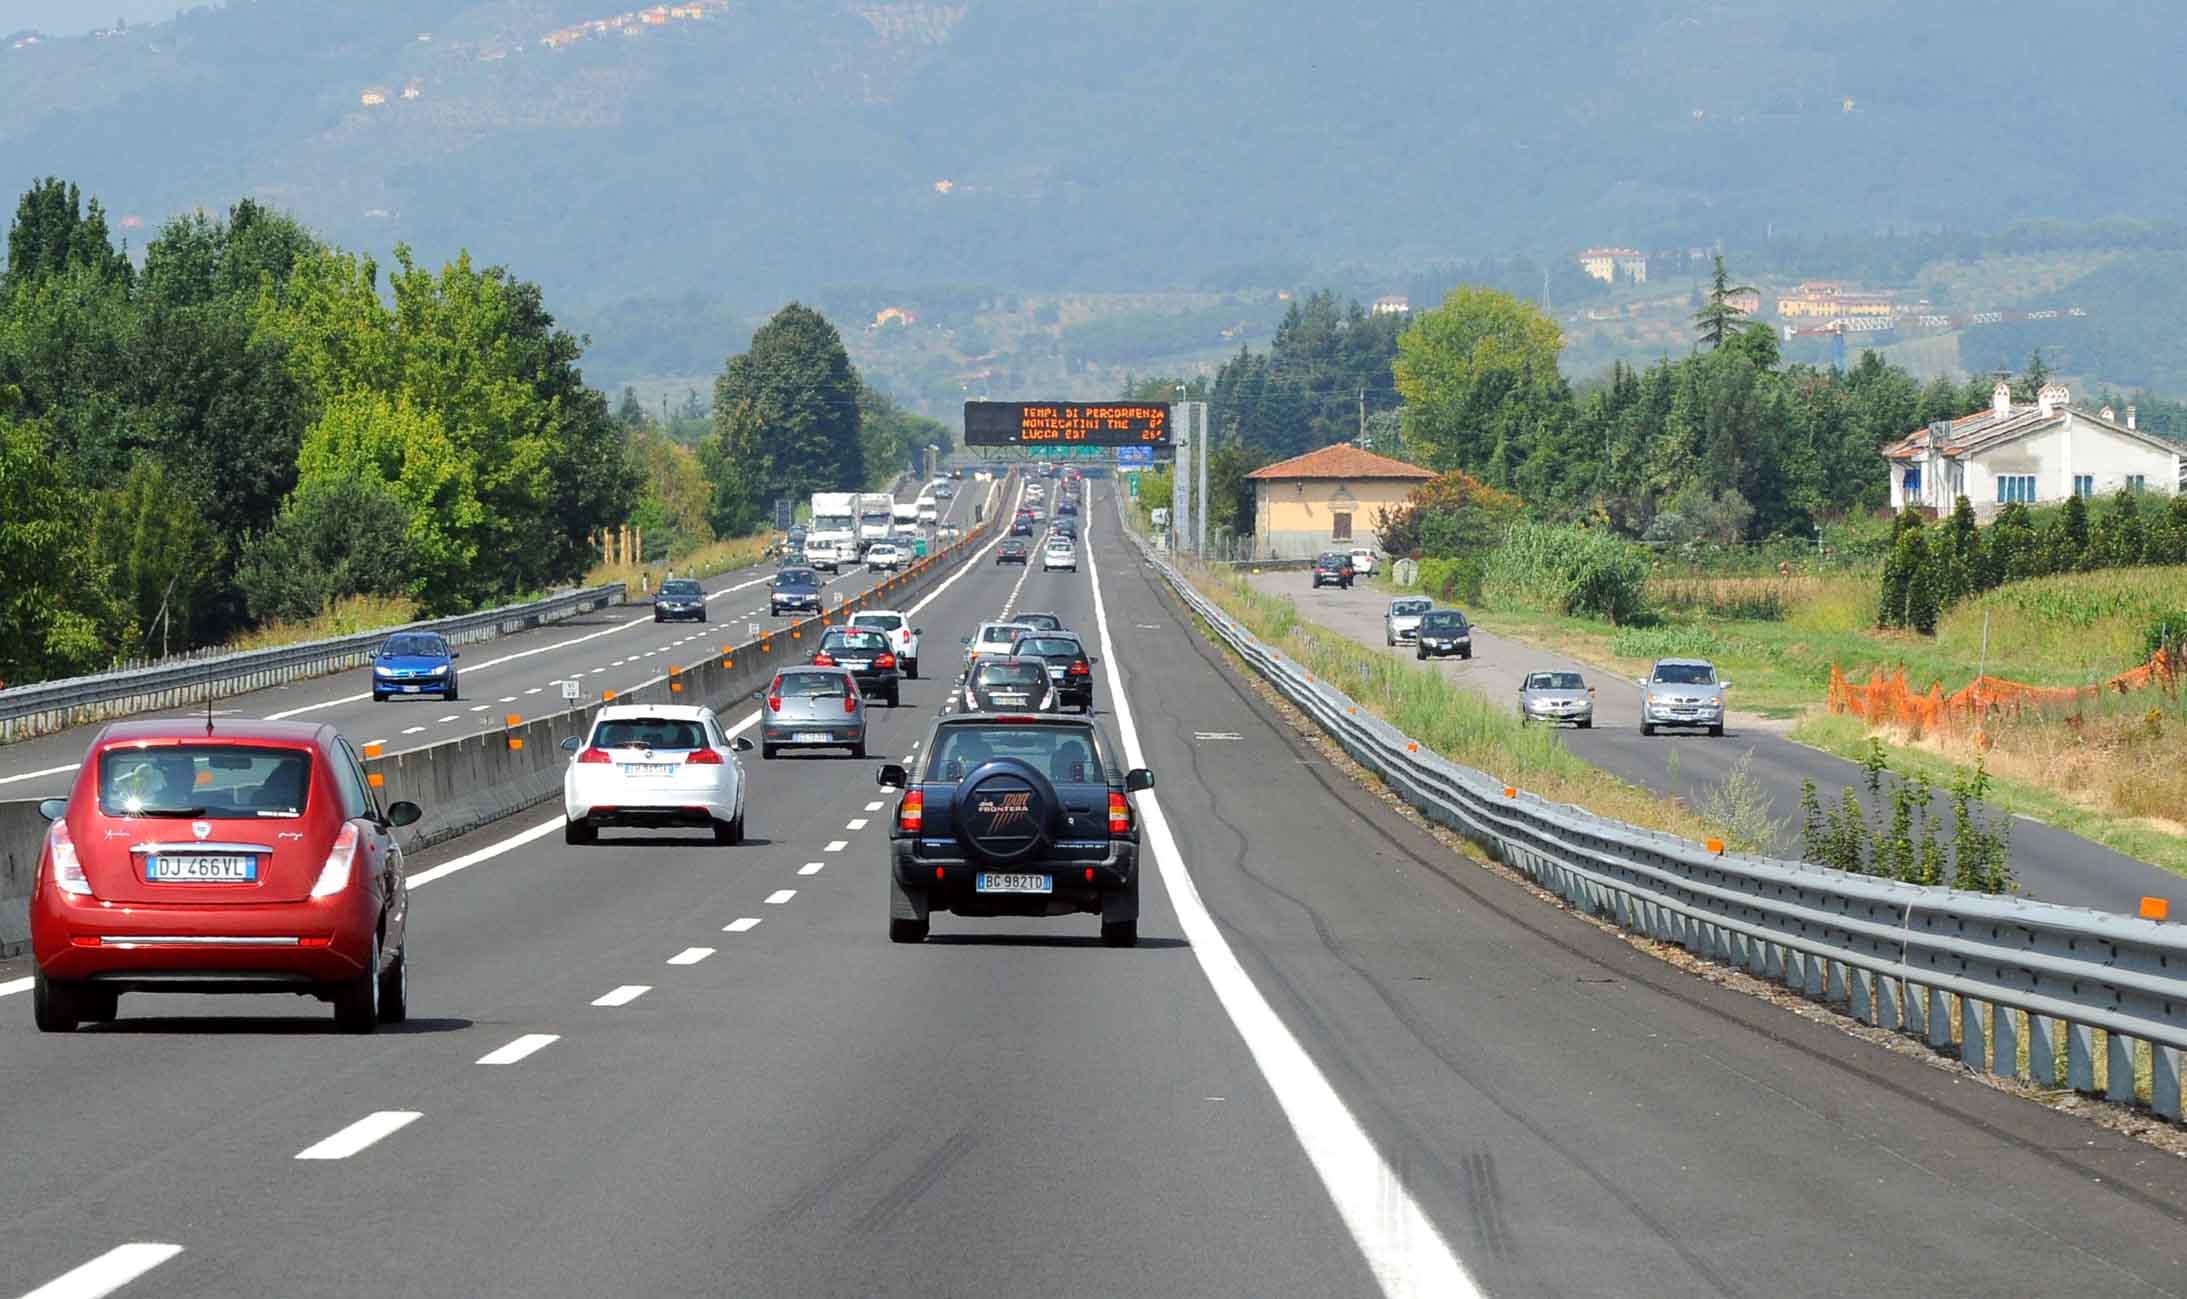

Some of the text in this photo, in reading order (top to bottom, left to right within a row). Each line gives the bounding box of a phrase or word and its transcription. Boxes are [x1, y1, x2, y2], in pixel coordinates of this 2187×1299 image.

[1023, 407, 1164, 419] TEMPI DI PERCORRENZA
[1022, 418, 1099, 430] MONTECATINI
[1021, 429, 1059, 440] LUCCA
[1064, 429, 1087, 440] EST
[159, 857, 244, 877] DJ 466VL
[1004, 875, 1043, 889] 982TD
